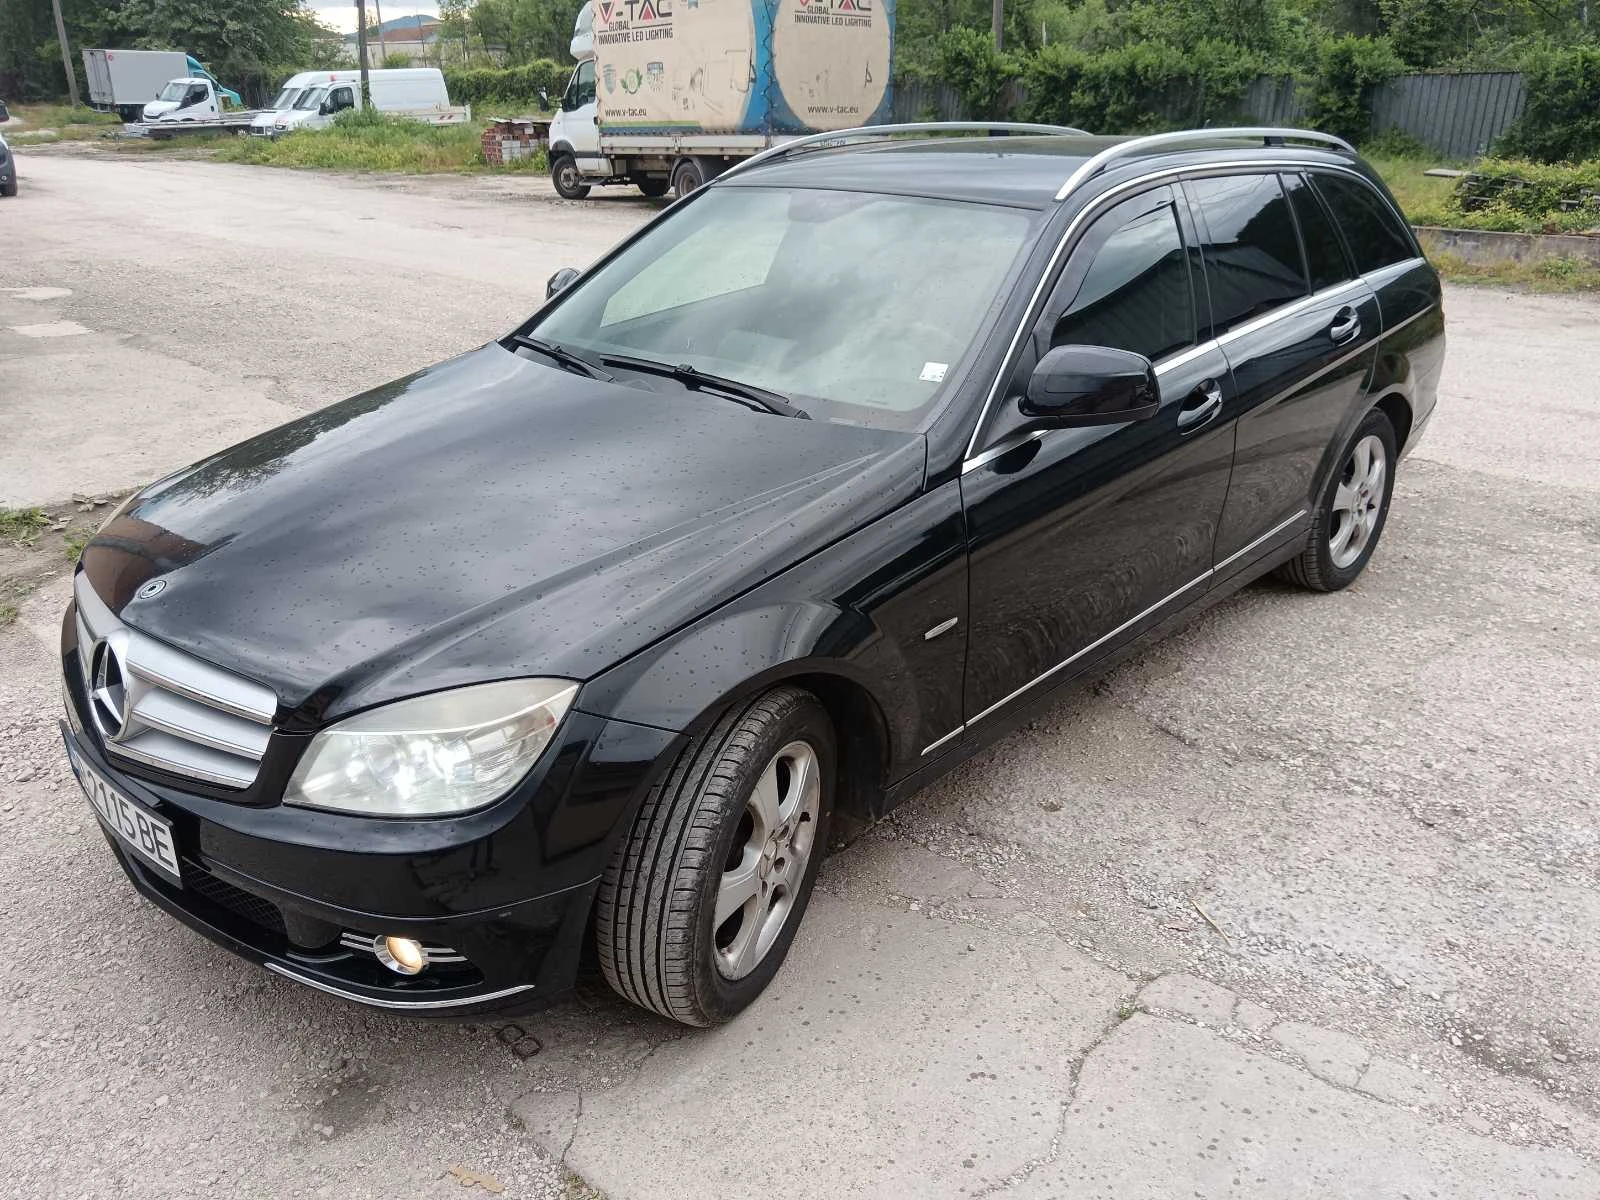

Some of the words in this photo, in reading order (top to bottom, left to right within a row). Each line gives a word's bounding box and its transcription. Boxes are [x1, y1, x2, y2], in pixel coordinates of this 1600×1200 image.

[598, 0, 673, 24] V-TAC
[807, 5, 830, 15] GLOBAL
[608, 20, 630, 32] GLOBAL
[794, 14, 830, 25] INNOVATIVE
[831, 17, 844, 26] LED
[844, 18, 872, 29] LIGHTING
[598, 33, 631, 45] INNOVATIVE
[632, 30, 644, 42] LED
[645, 28, 673, 41] LIGHTING
[605, 107, 647, 117] www.v-tac.eu
[808, 105, 859, 114] www.v-tac.eu
